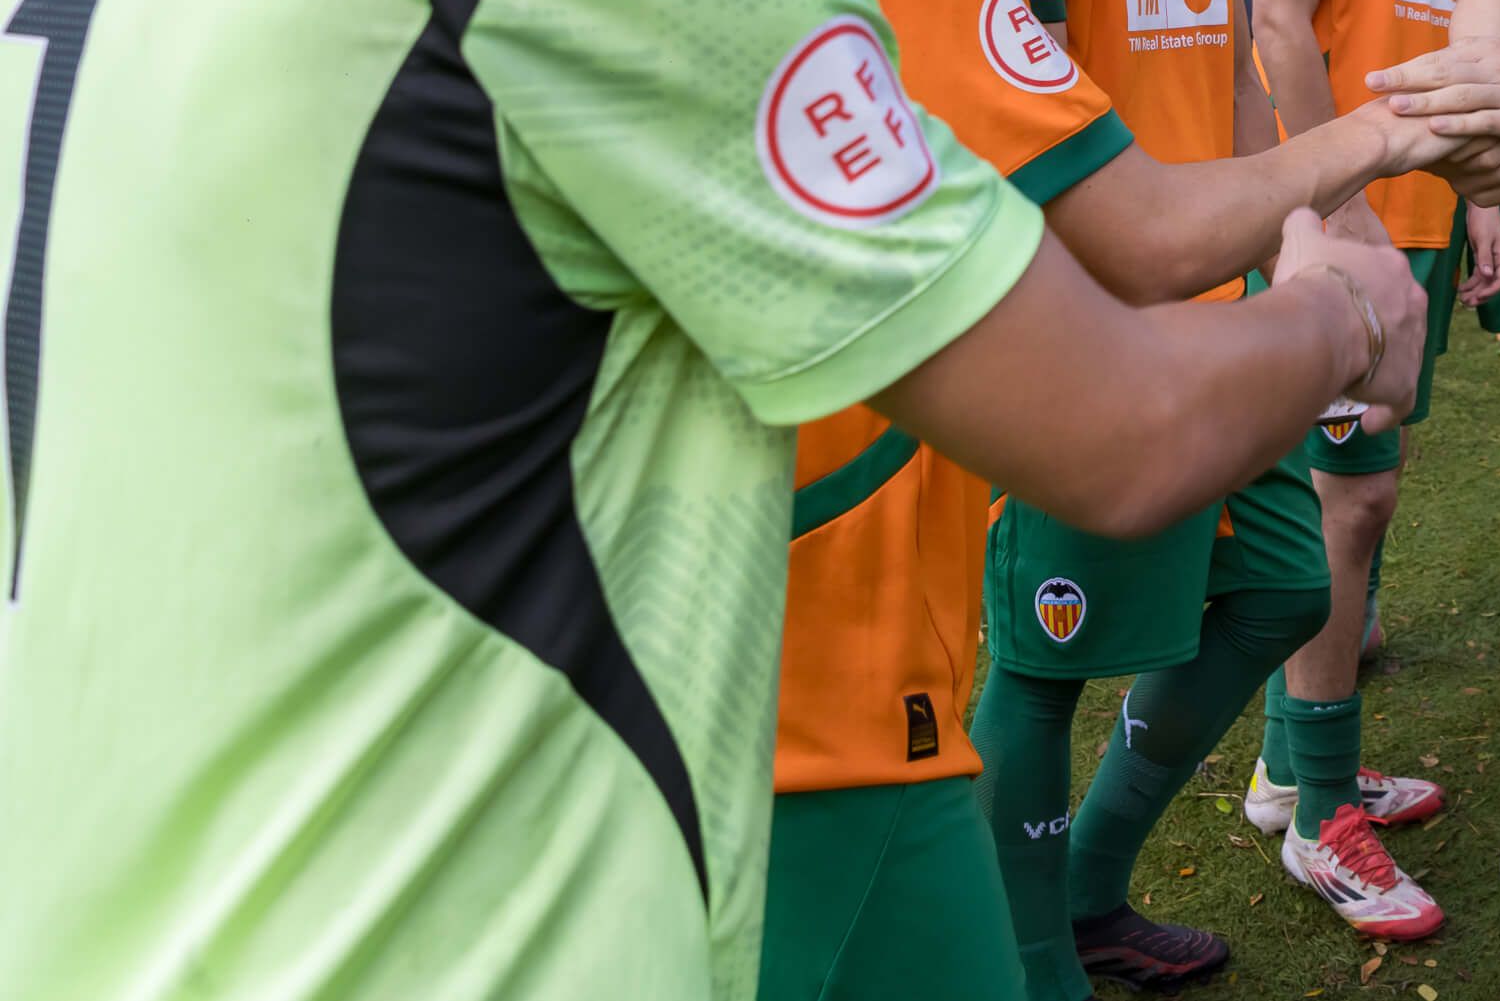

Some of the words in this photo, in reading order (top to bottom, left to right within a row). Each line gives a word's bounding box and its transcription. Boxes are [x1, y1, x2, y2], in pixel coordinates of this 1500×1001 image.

[1407, 7, 1431, 23] Real
[1128, 37, 1141, 53] TM
[1142, 34, 1159, 51] Real
[1160, 34, 1194, 50] Estate
[1195, 31, 1228, 48] Group
